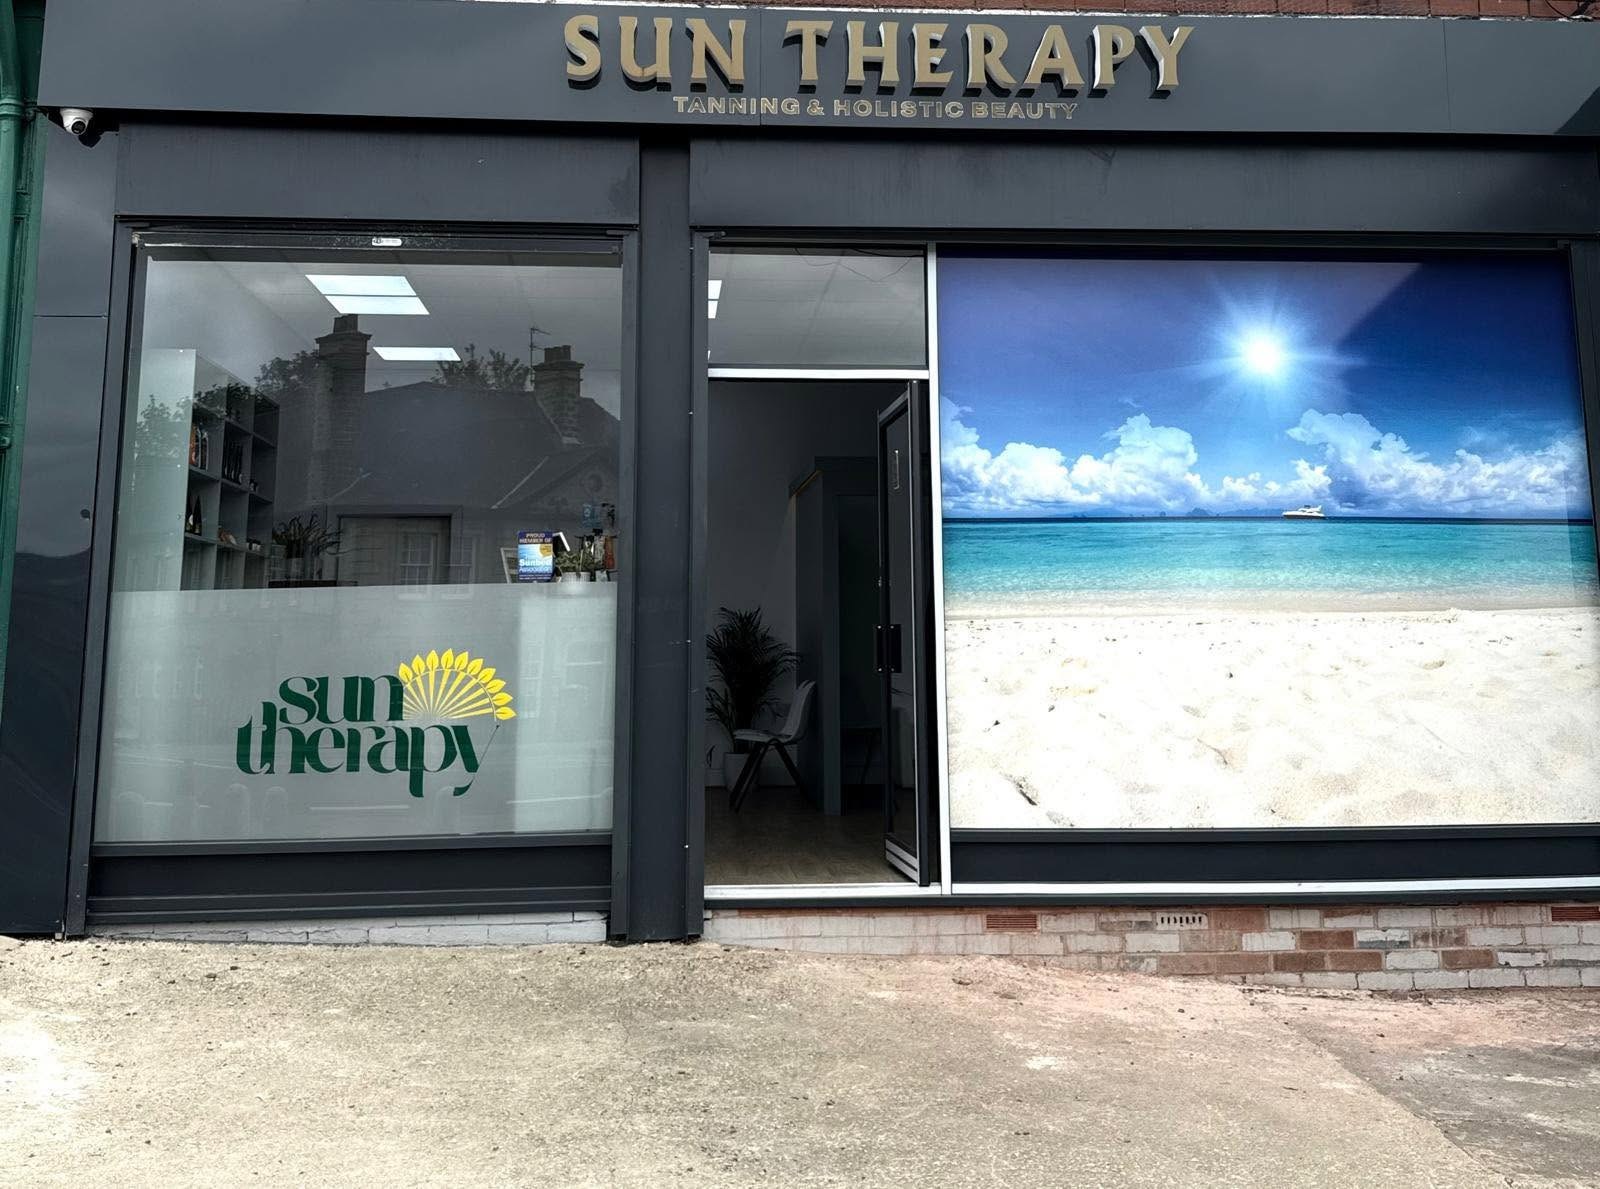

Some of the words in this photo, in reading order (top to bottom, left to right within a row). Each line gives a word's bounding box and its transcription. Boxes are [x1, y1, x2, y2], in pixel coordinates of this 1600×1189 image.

[563, 15, 746, 86] SUN
[785, 19, 1194, 91] THERAPY
[673, 96, 800, 115] TANNING
[806, 99, 825, 116] &
[833, 99, 964, 118] HOLISTIC
[971, 102, 1078, 120] BEAUTY
[278, 675, 404, 724] sun
[236, 701, 499, 798] therapy
